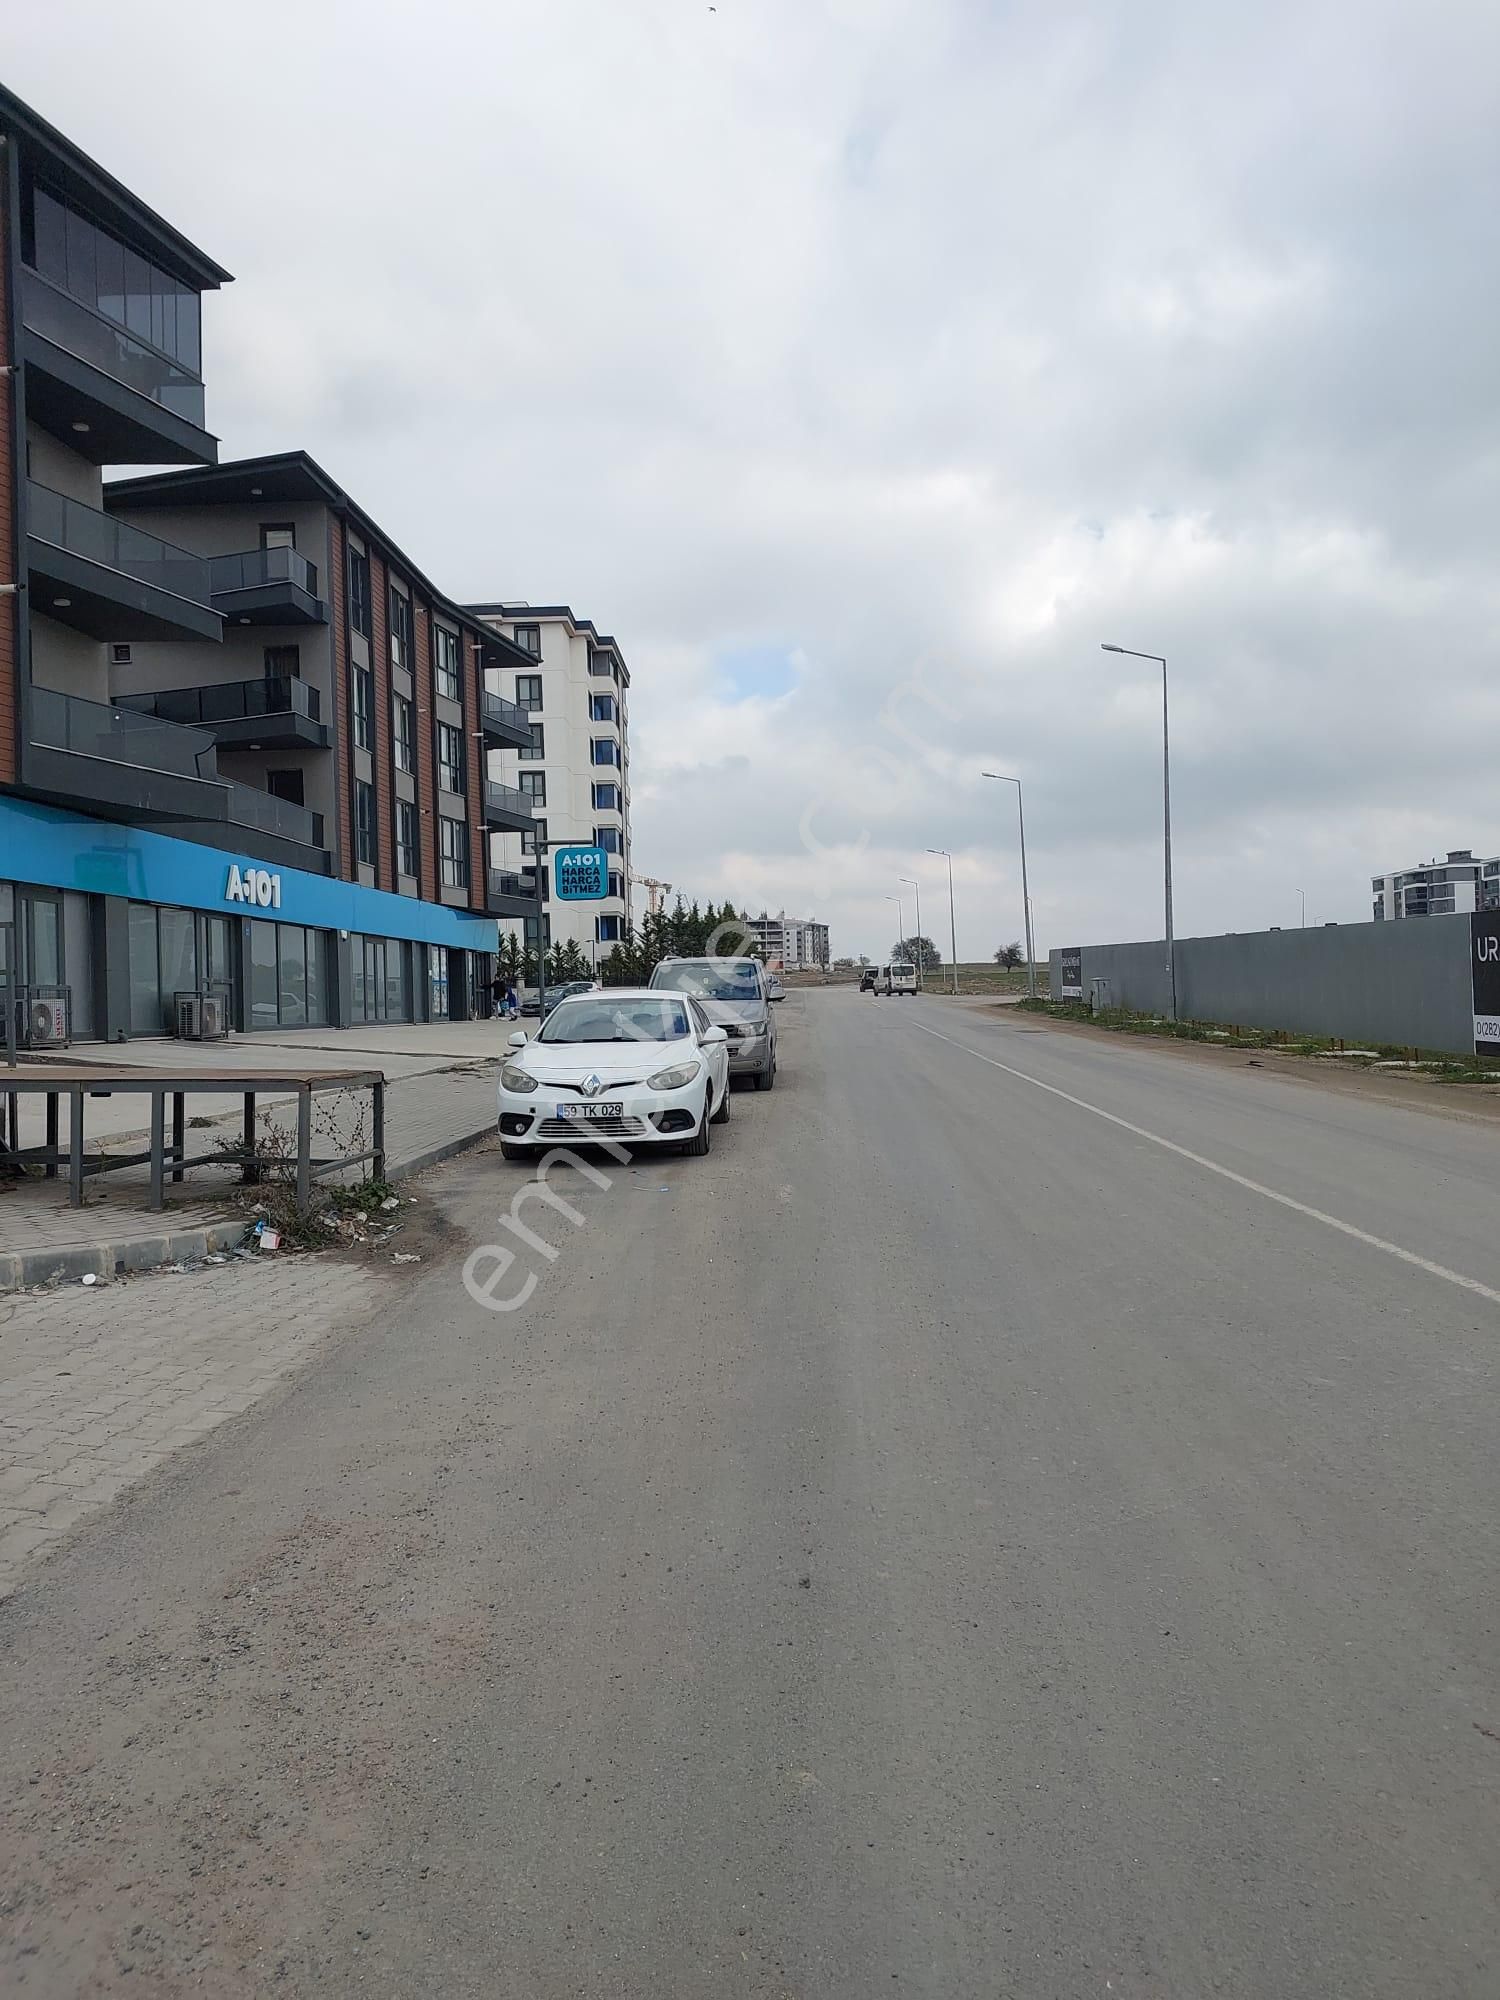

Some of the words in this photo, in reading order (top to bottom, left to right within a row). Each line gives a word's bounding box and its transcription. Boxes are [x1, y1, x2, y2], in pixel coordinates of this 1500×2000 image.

[561, 867, 600, 876] HARCA
[561, 876, 600, 885] HARCA
[1477, 936, 1500, 961] UR
[563, 1106, 577, 1117] 59
[581, 1105, 597, 1117] TK
[601, 1105, 622, 1116] 029
